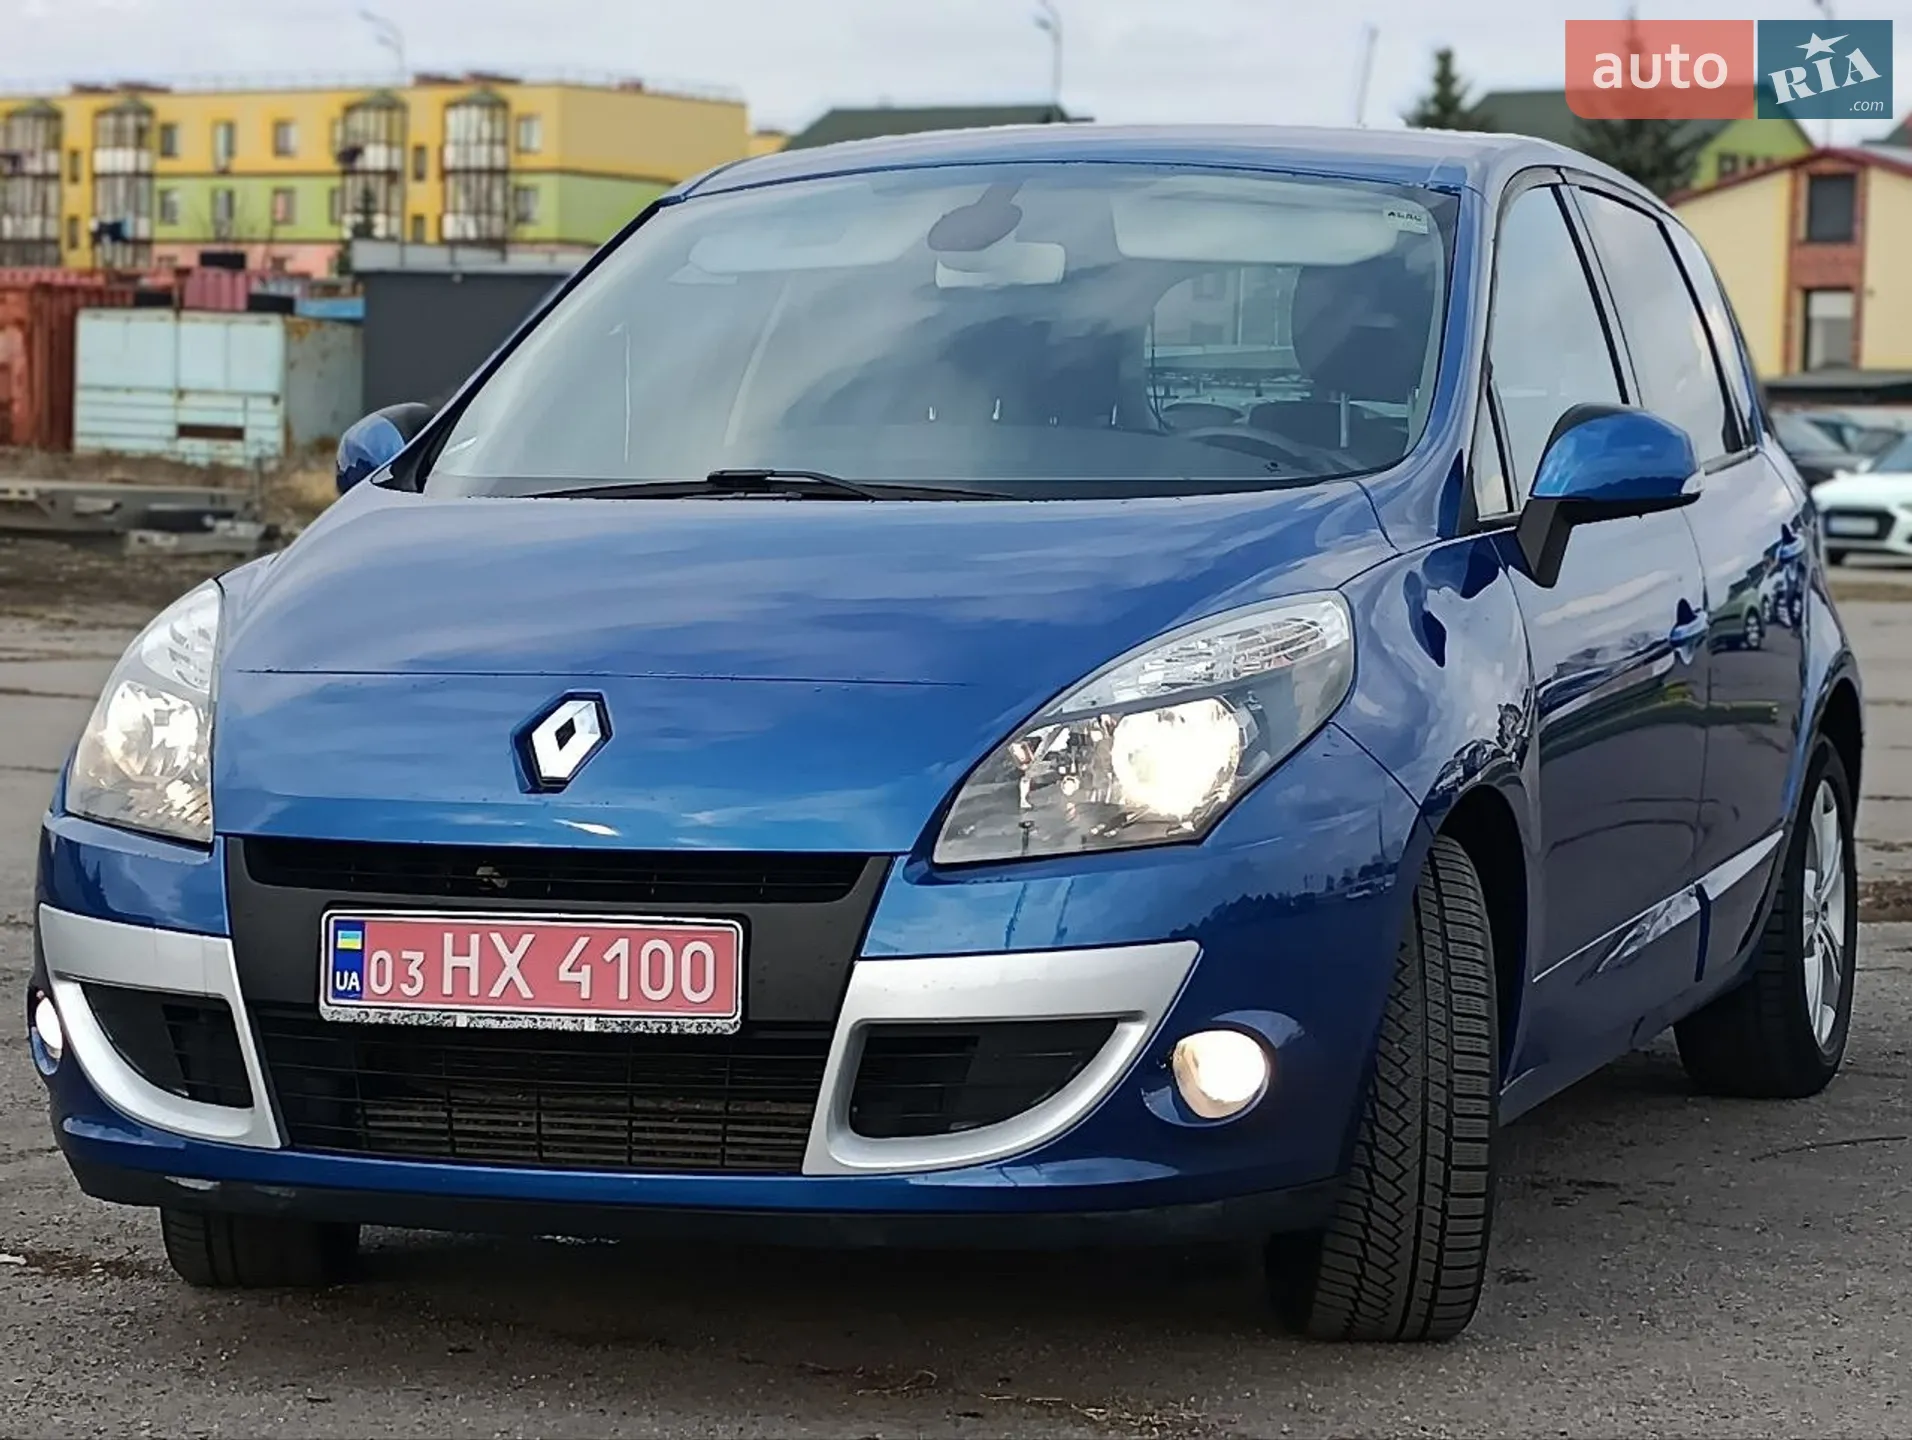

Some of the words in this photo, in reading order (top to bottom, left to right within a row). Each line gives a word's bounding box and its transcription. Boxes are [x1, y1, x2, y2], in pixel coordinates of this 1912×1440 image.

[336, 971, 360, 992] UA
[369, 949, 425, 997] 03
[441, 932, 536, 999] HX
[557, 936, 716, 1003] 4100
